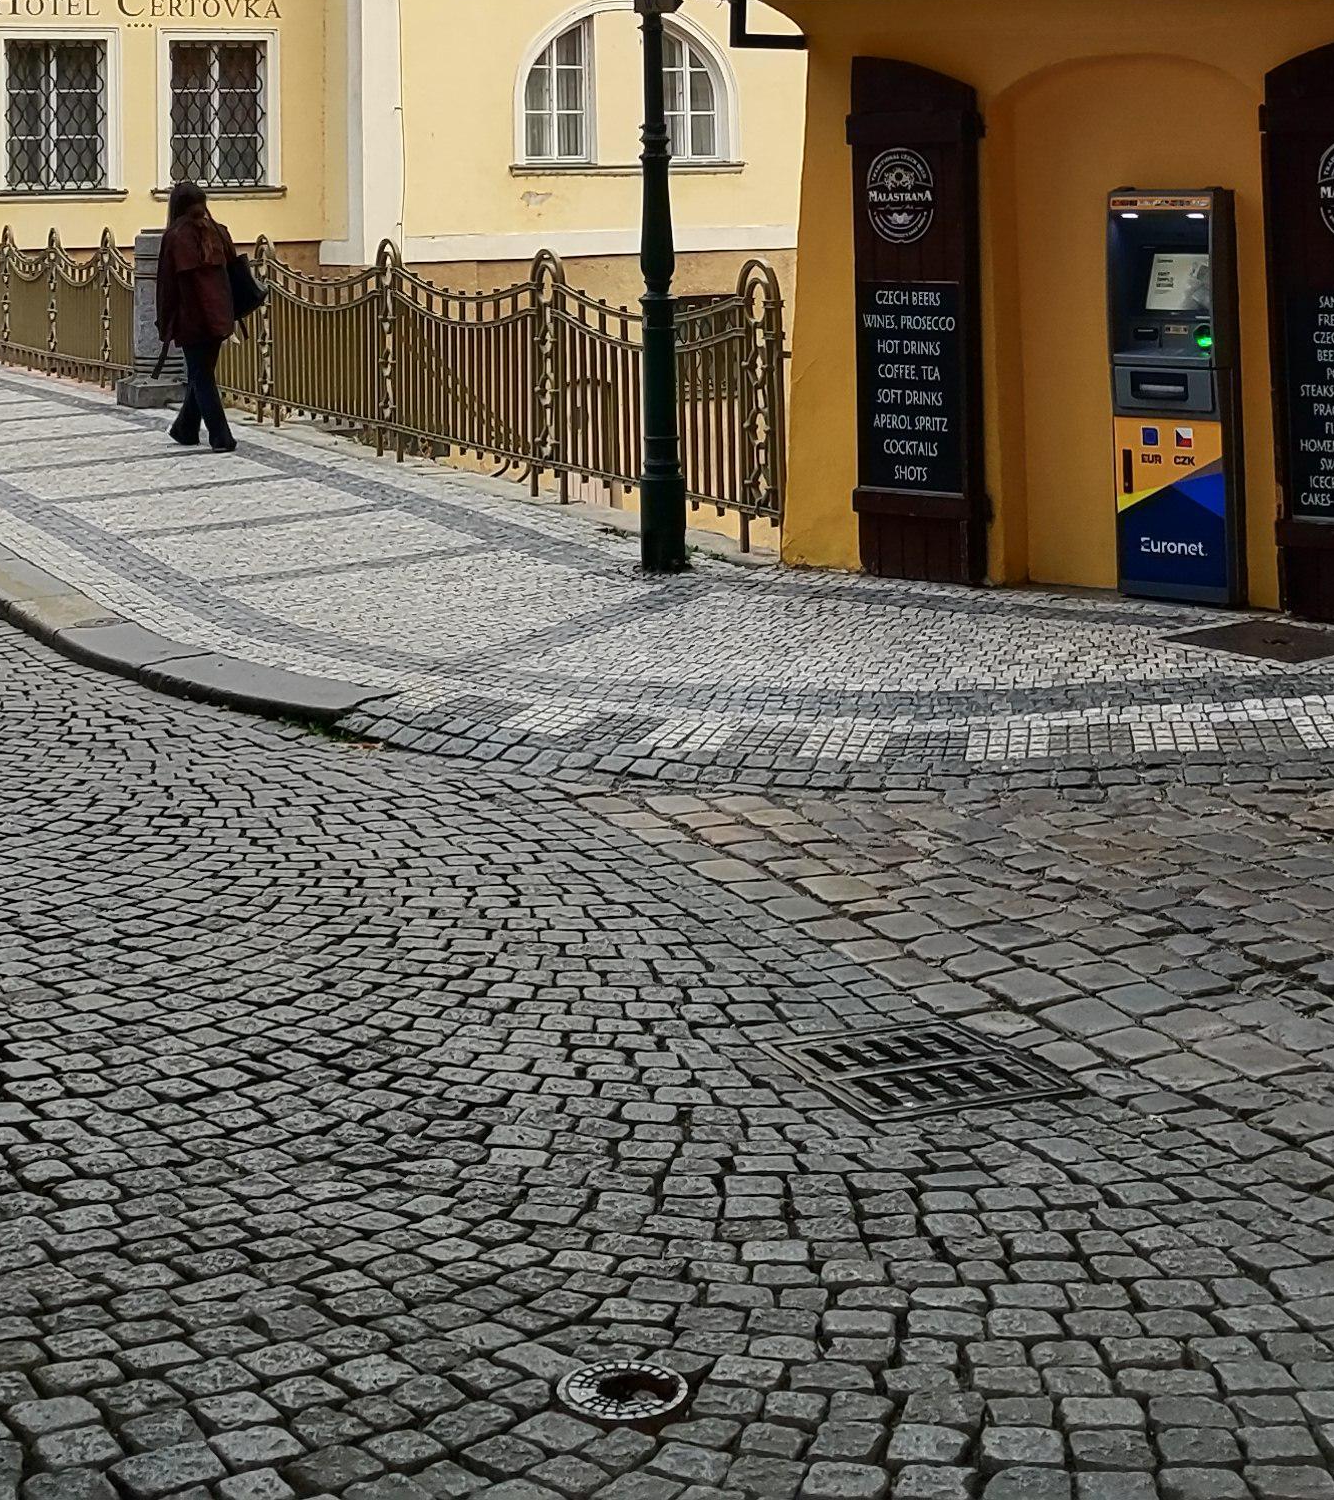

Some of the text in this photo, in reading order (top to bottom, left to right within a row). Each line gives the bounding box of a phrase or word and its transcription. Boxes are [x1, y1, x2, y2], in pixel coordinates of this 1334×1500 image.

[868, 190, 933, 202] MALASTRANA
[875, 290, 941, 306] CZECH BEERS
[863, 313, 955, 331] WINES, PROSECCO
[877, 339, 941, 356] HOT DRINKS
[878, 363, 941, 381] COFFEE, TEA
[877, 388, 943, 406] SOFT DRINKS
[873, 413, 948, 432] APEROL SPRITZ
[883, 438, 939, 457] COCKTAILS
[1141, 453, 1195, 466] EUR CZK
[894, 464, 928, 482] SHOTS
